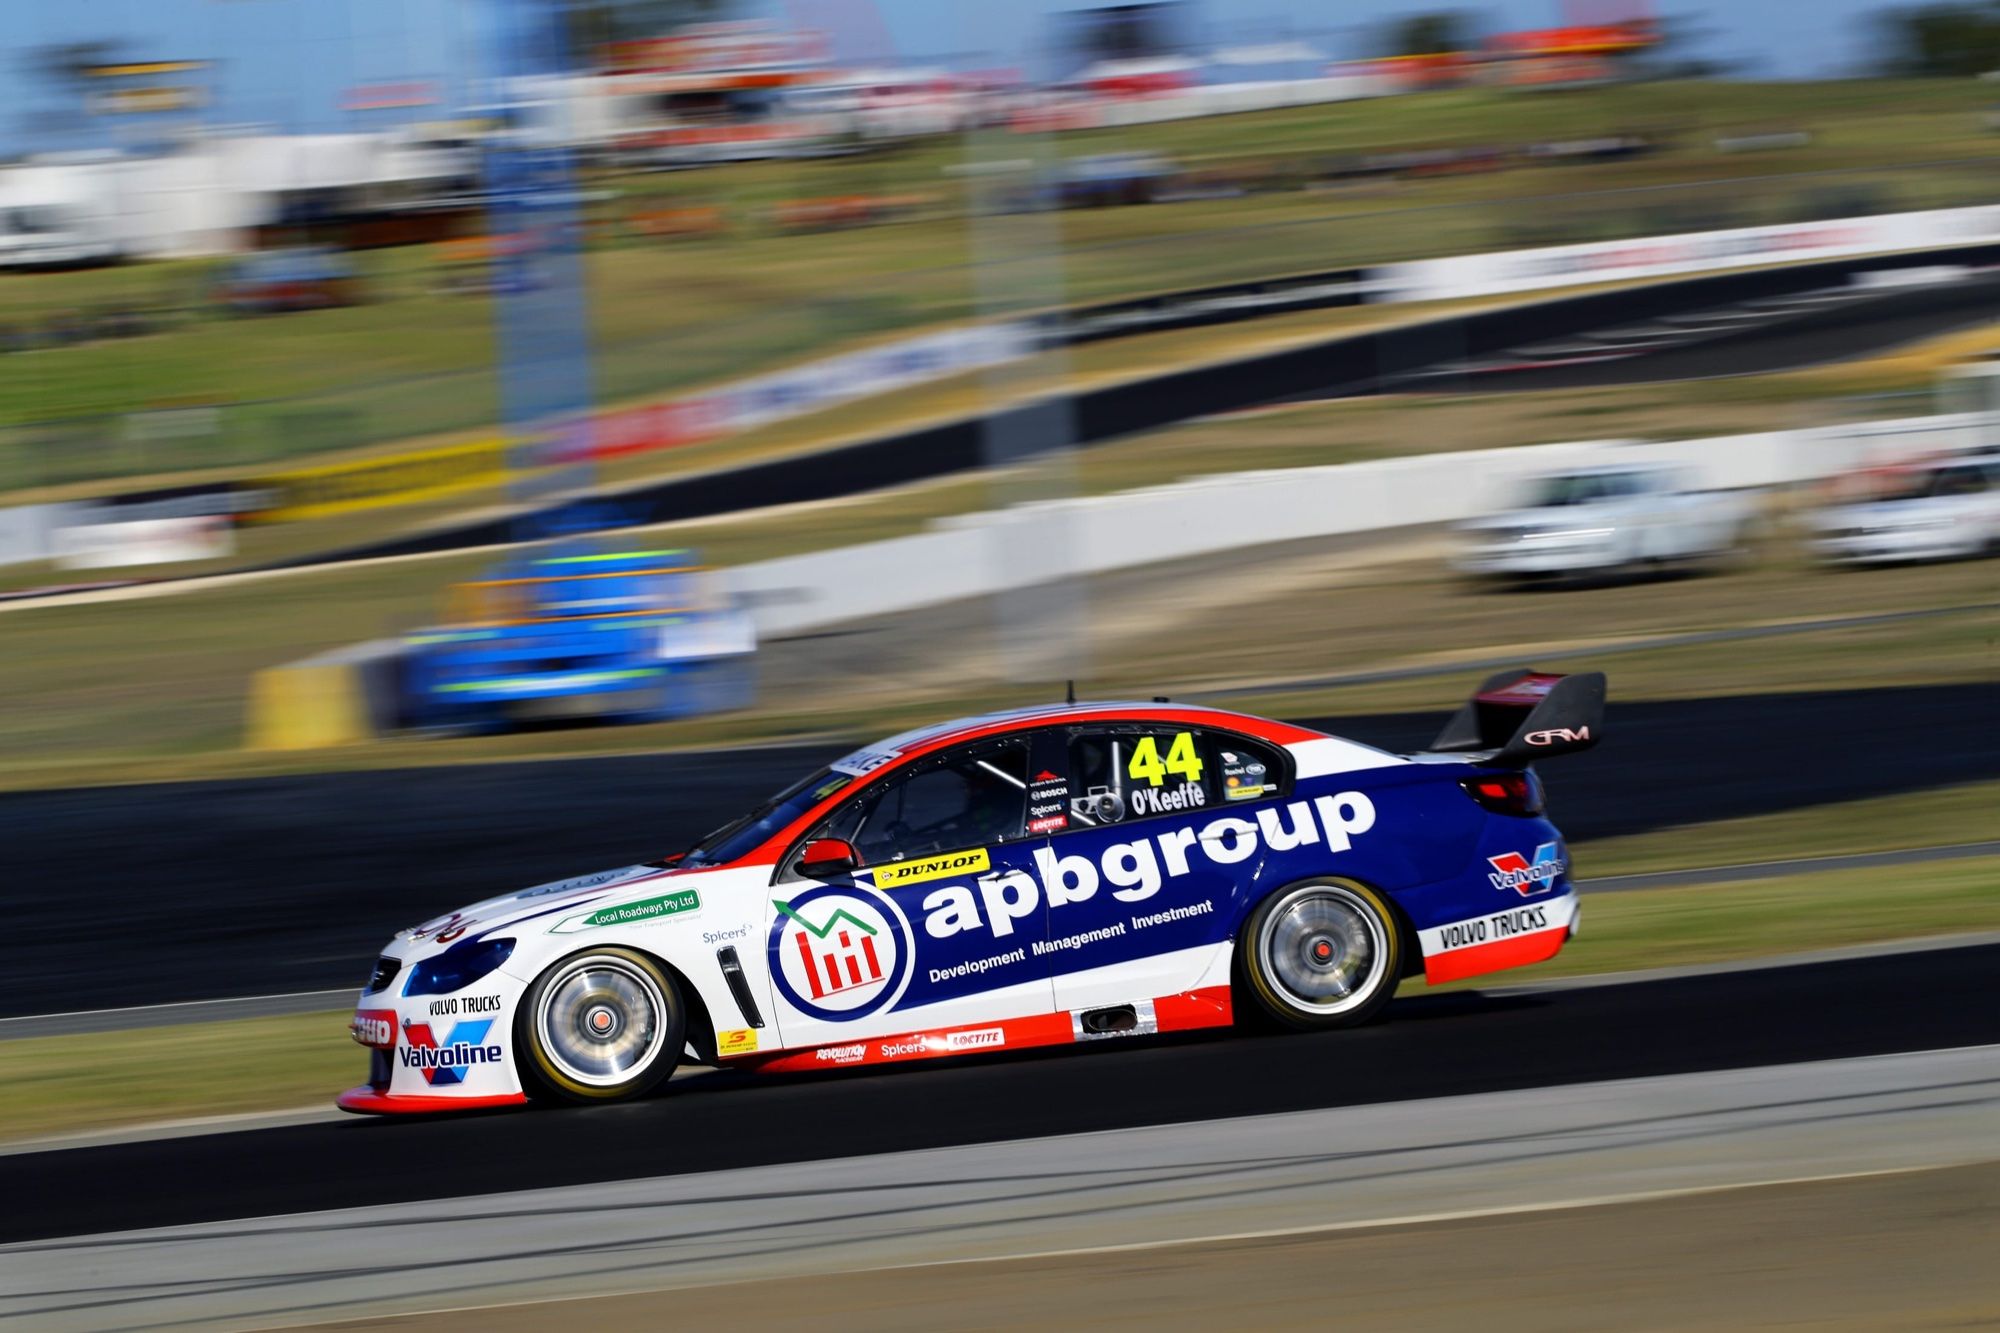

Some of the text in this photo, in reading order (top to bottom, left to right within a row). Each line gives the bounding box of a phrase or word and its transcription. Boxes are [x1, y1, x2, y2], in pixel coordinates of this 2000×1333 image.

[1128, 731, 1203, 787] 44
[1040, 787, 1068, 798] BOSCH
[1131, 781, 1206, 816] O'Keeffe
[1031, 803, 1062, 817] Spicers
[1033, 817, 1064, 830] LOCTITE
[896, 854, 982, 878] DUNLOP
[923, 791, 1376, 938] apbgroup
[1488, 859, 1565, 890] Valvoline
[594, 895, 695, 924] Local Roadways Pty Ltd
[703, 927, 747, 944] Spicers
[1440, 906, 1547, 950] VOLVO TRUCKS
[929, 899, 1214, 983] Development Management Investment
[429, 995, 501, 1016] VOLVO TRUCKS
[881, 1040, 926, 1058] Spicers
[952, 1031, 999, 1046] LOCTITE
[400, 1042, 502, 1068] Valvoline
[815, 1044, 867, 1060] REVOLUTION
